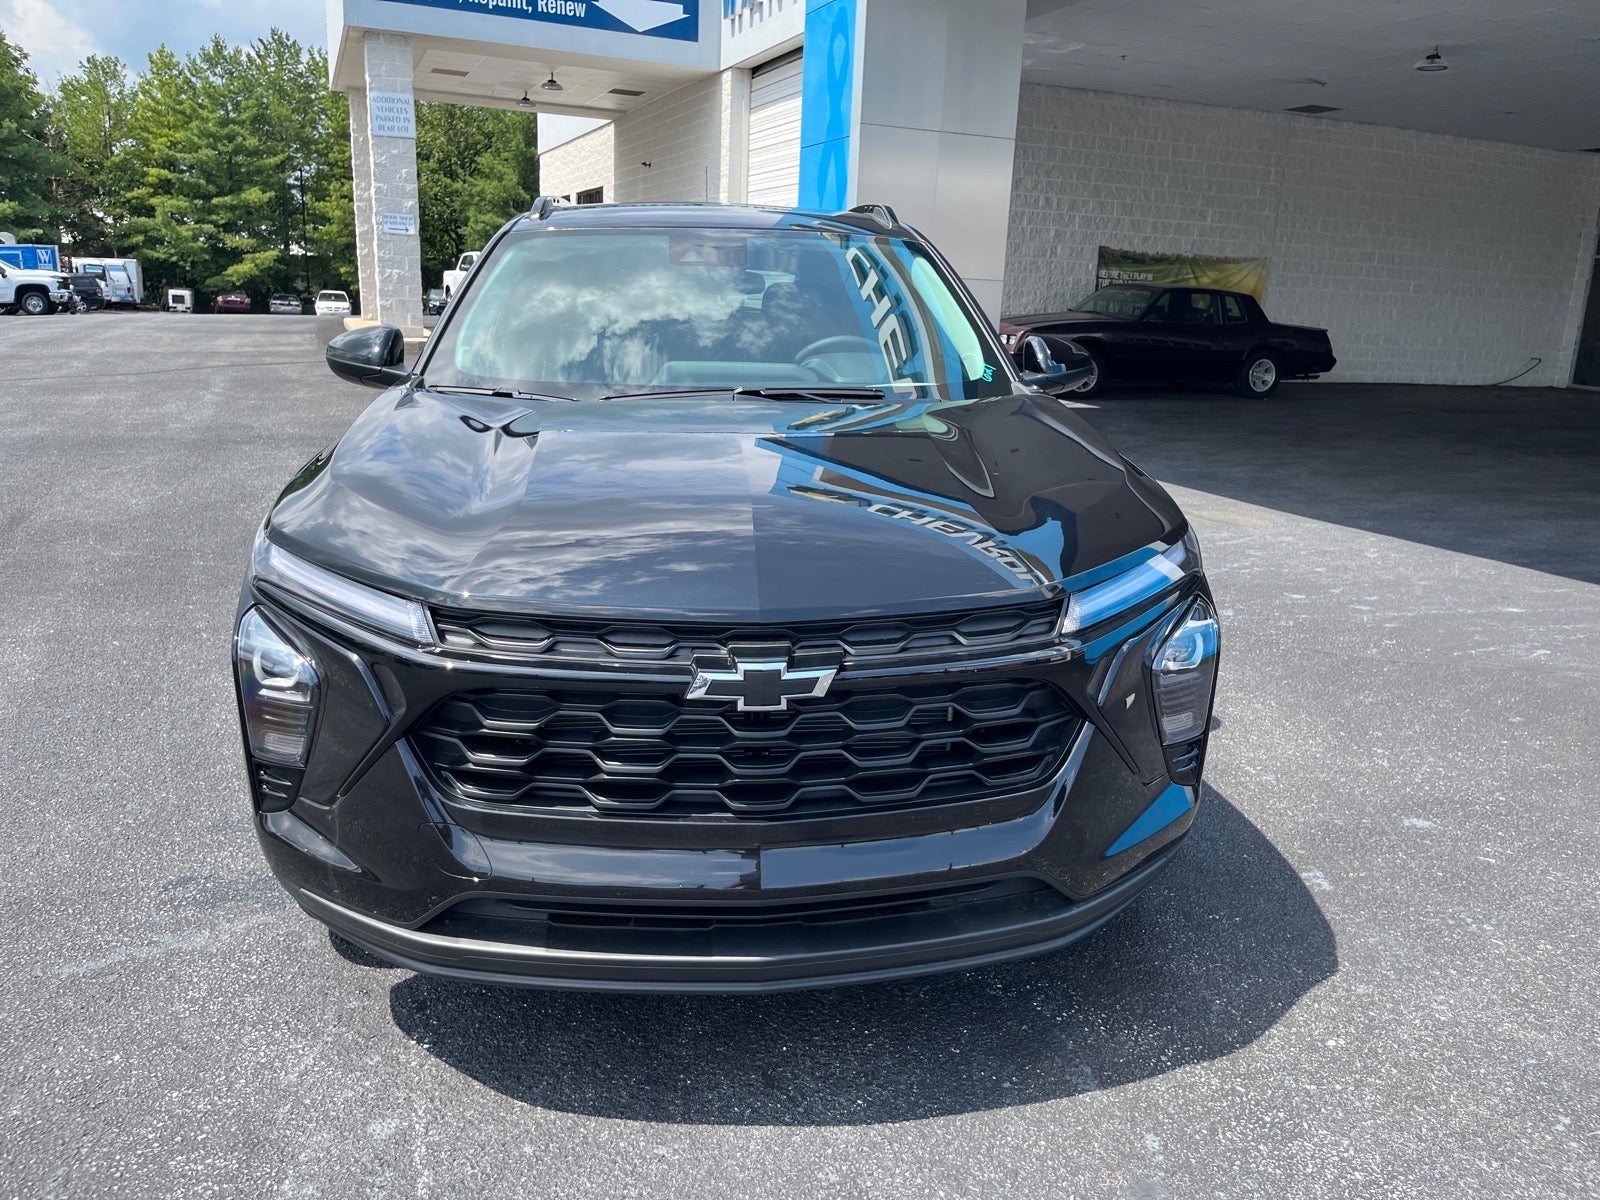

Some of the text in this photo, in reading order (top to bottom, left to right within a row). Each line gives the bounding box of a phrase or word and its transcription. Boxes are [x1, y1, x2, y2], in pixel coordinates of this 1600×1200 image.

[468, 0, 587, 18] paint, Renew
[372, 96, 411, 105] ADDITIONAL
[376, 105, 409, 115] VEHICLES
[375, 115, 401, 123] PARKED
[377, 124, 409, 133] REAR LOT
[1099, 270, 1119, 279] BEFORE
[1120, 271, 1133, 280] THEY
